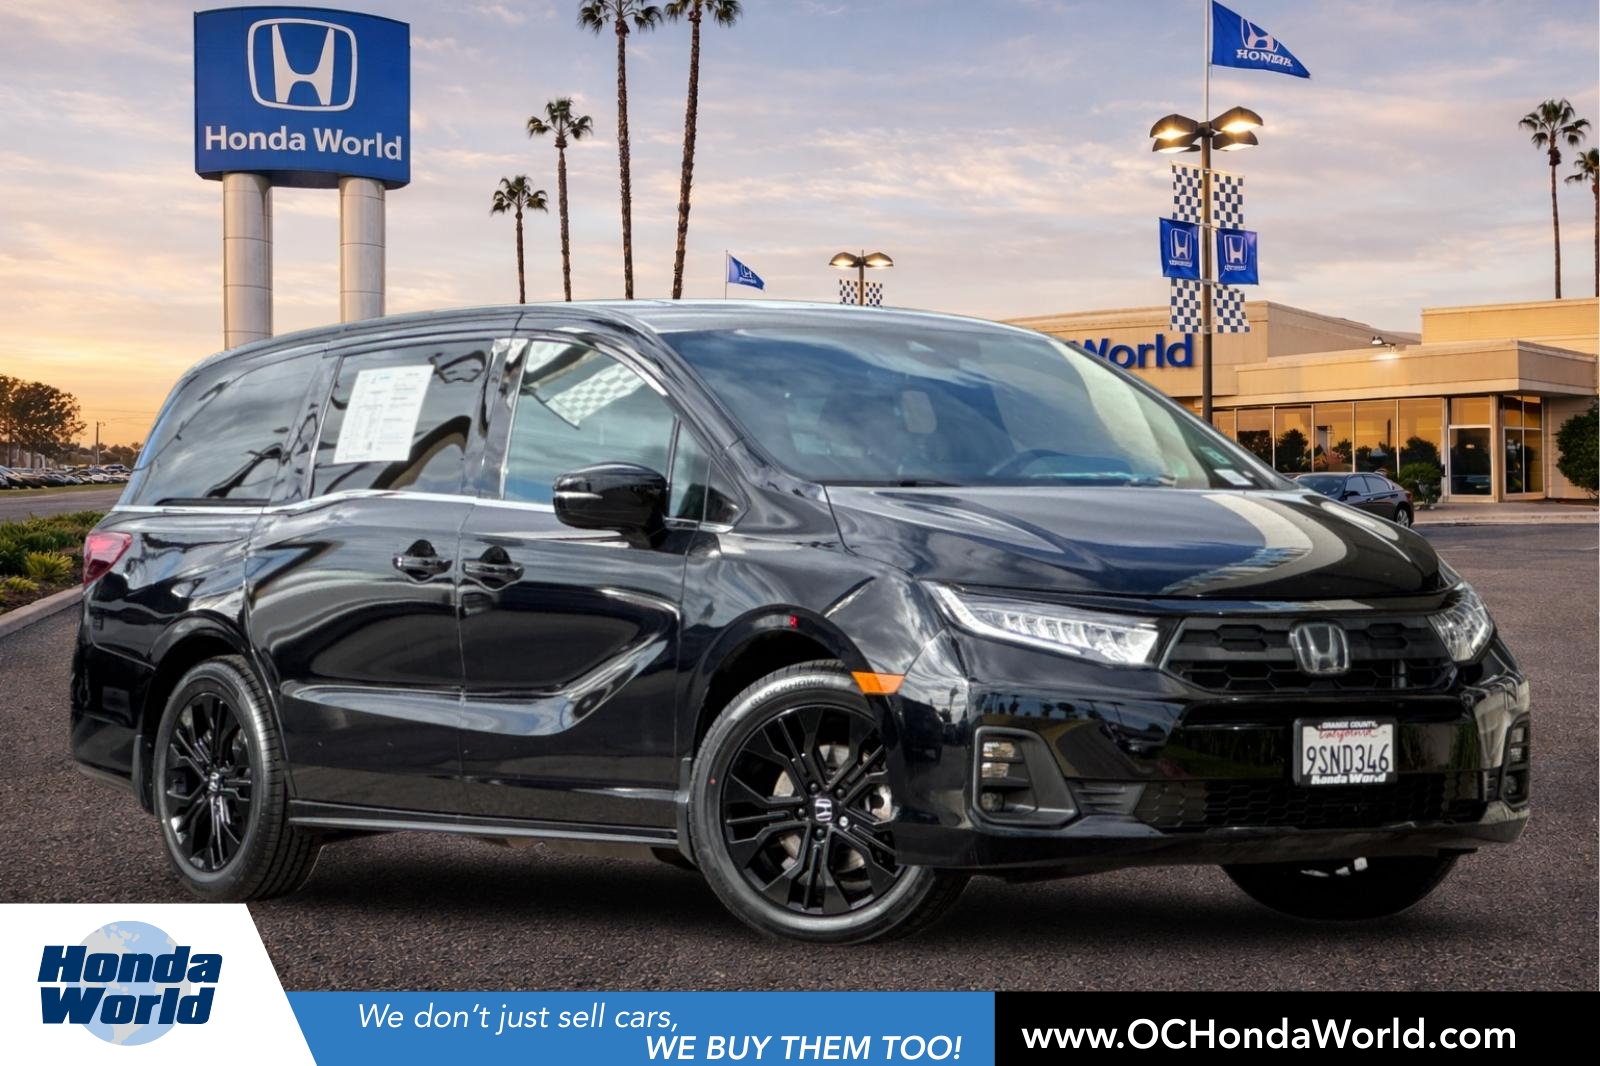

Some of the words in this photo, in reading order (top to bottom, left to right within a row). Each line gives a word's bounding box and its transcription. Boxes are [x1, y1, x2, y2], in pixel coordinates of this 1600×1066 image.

[205, 125, 306, 151] Honda
[313, 128, 402, 161] World
[1306, 744, 1389, 775] 9SND346
[1311, 774, 1348, 785] Honda
